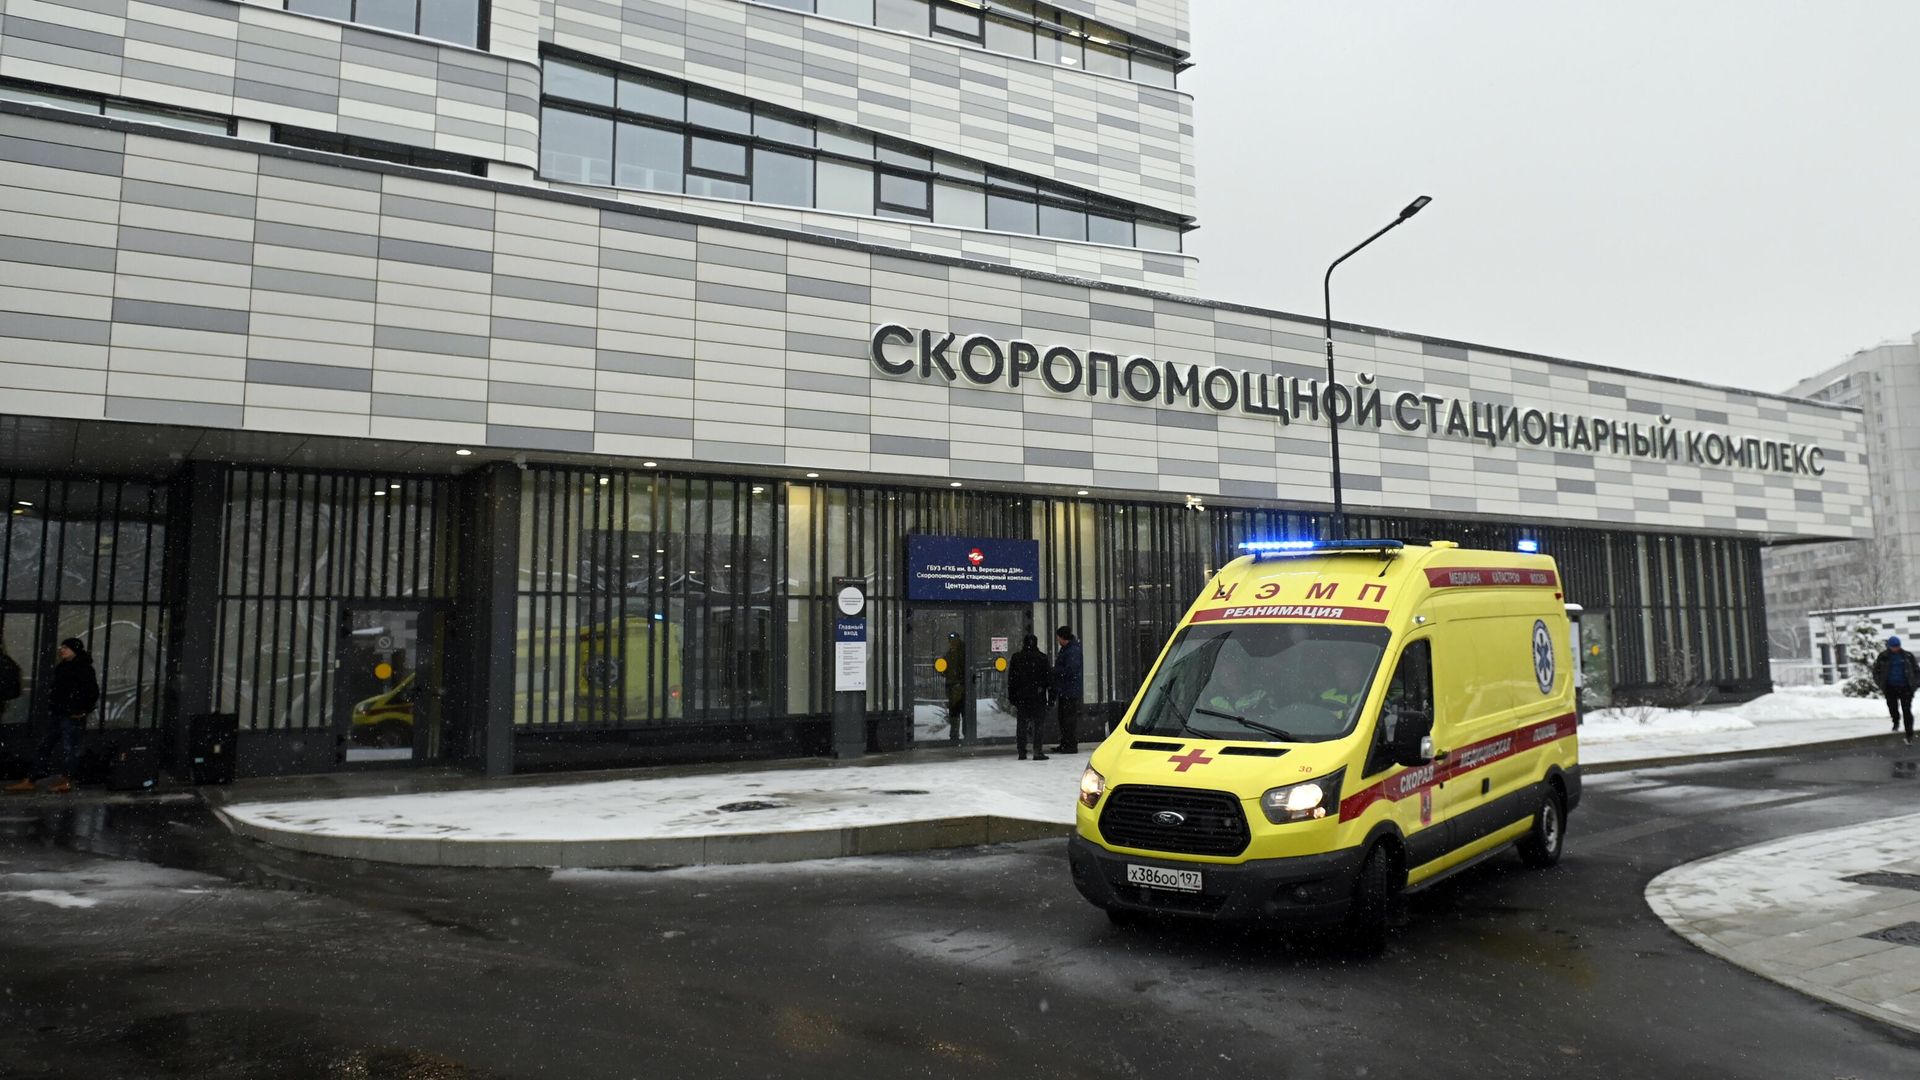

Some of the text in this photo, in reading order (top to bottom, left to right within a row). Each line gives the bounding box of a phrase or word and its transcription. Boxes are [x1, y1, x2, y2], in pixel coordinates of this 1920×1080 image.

[872, 323, 1825, 477] СКОРОПОМОЩНОЙ СТАЦИОНАРНЫЙ КОМПЛЕКС
[916, 571, 965, 580] Скоропомощной
[966, 573, 1006, 581] стационарный
[944, 582, 990, 590] Центральный
[1223, 606, 1344, 618] РЕАНИМАЦИЯ
[838, 623, 864, 631] Главный
[1298, 764, 1313, 774] 30
[1399, 765, 1434, 793] СКОРАЯ
[1179, 871, 1199, 885] 197
